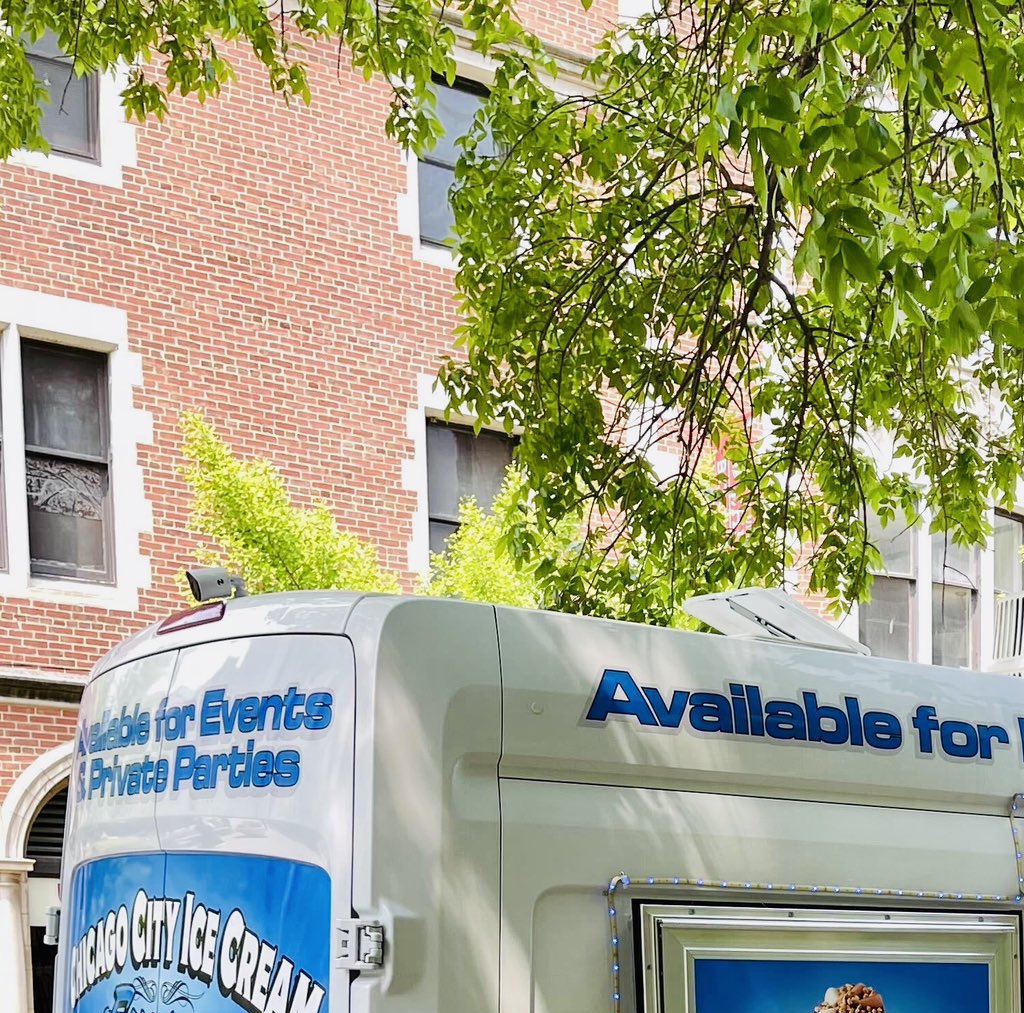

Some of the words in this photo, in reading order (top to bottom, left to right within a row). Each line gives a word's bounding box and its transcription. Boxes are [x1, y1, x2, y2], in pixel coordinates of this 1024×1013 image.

[155, 697, 196, 742] for
[199, 687, 333, 737] Events
[586, 669, 902, 750] Available
[912, 705, 1009, 760] for
[87, 754, 169, 800] Private
[173, 739, 301, 791] Parties
[130, 888, 181, 969] CITY
[179, 890, 221, 980] ICE
